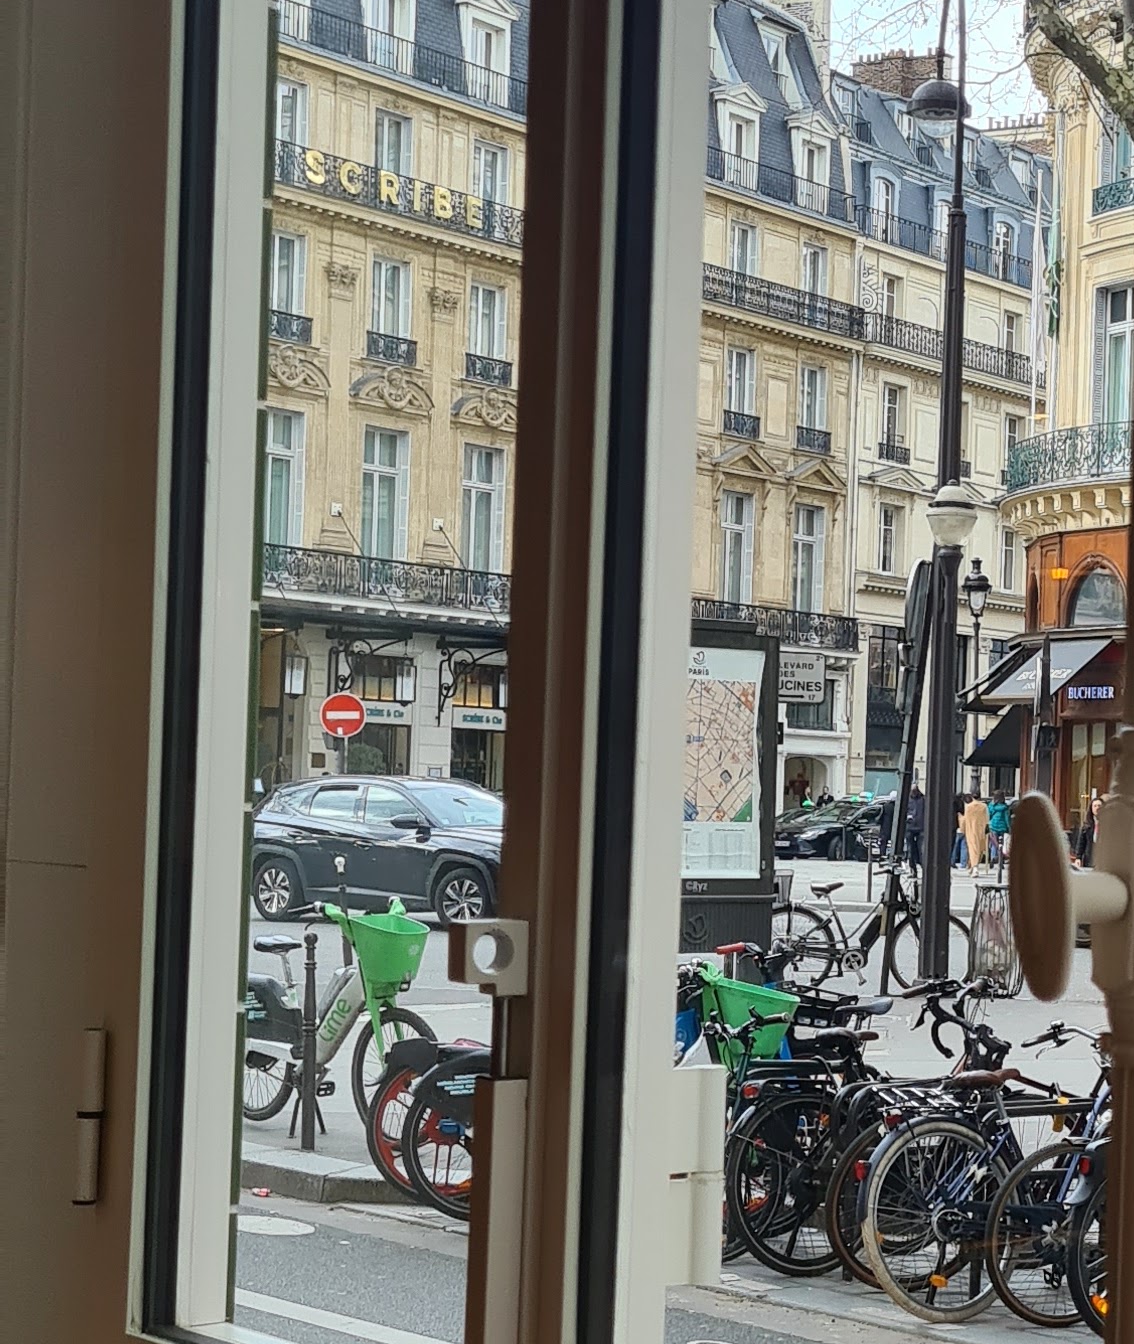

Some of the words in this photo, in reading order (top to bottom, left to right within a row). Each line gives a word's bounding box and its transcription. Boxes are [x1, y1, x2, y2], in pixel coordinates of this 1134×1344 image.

[305, 149, 483, 229] SCRIBE
[688, 667, 709, 676] PARIS
[1067, 686, 1115, 699] BUCHERER
